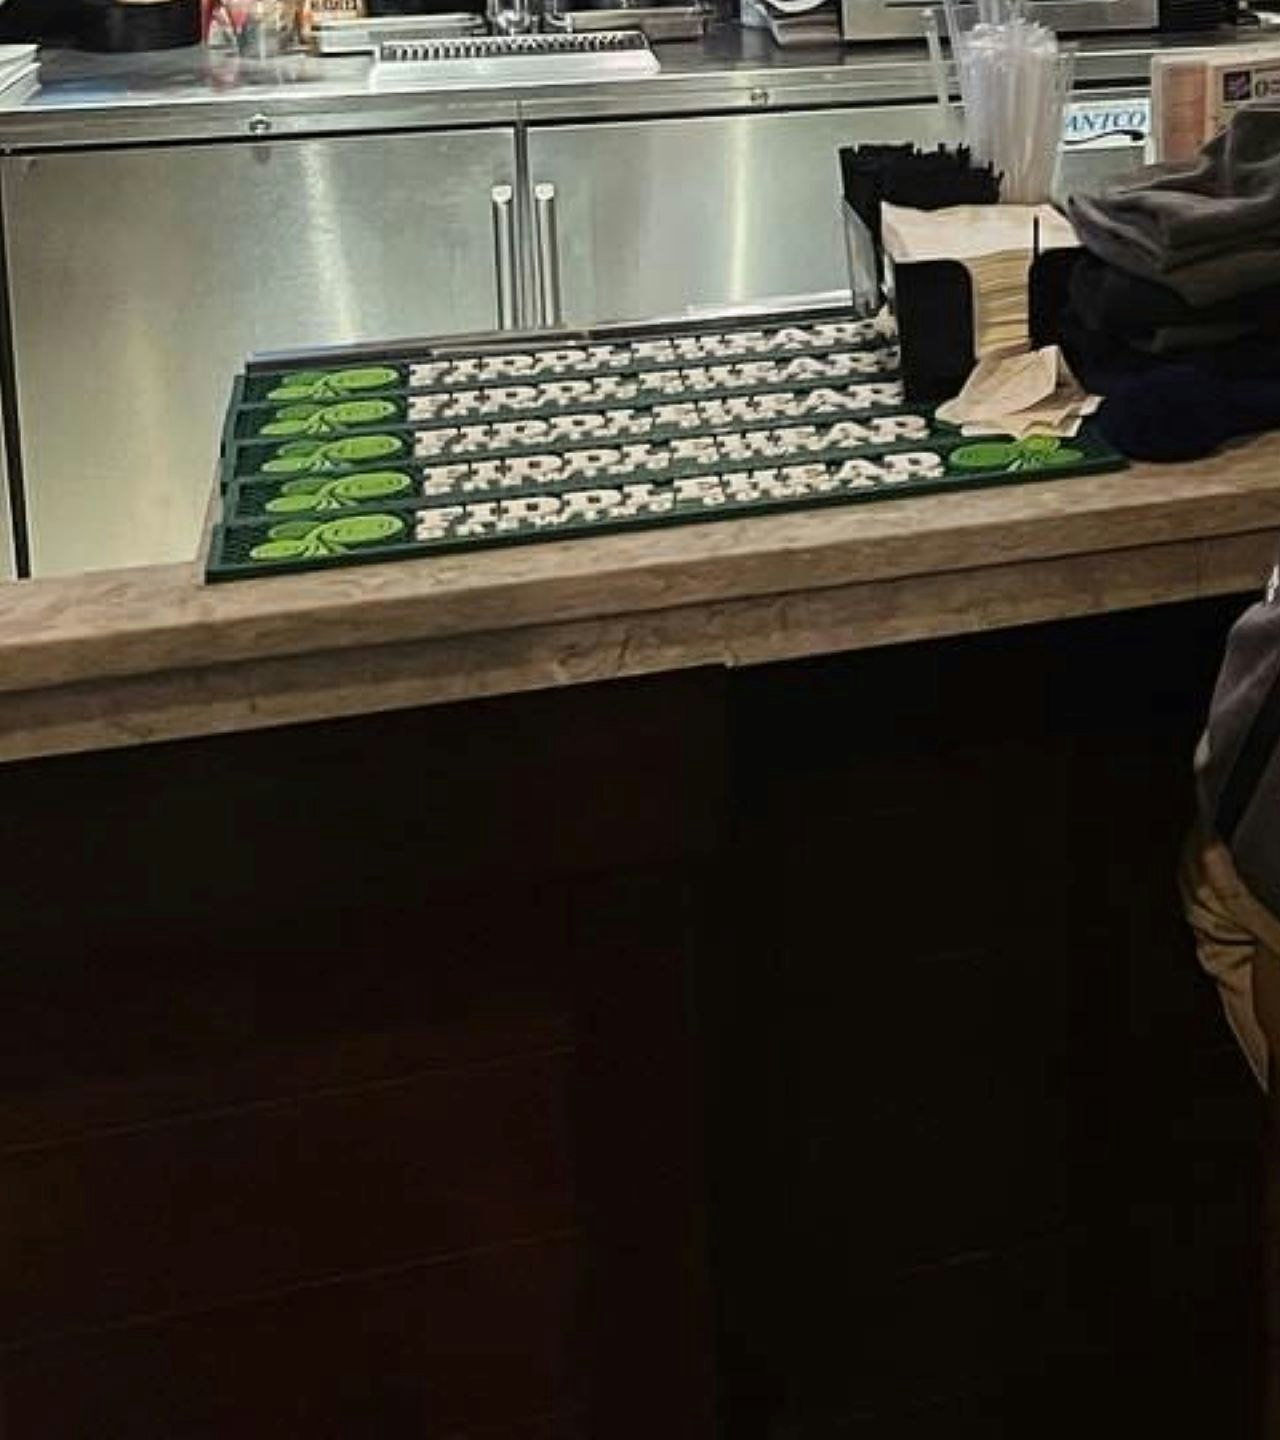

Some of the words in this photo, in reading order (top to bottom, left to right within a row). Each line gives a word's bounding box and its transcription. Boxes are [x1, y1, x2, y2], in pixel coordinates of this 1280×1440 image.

[1066, 111, 1147, 132] ANTCO
[423, 414, 931, 496] FIDDLEHEAD
[414, 451, 945, 542] FIDDLEHEAD
